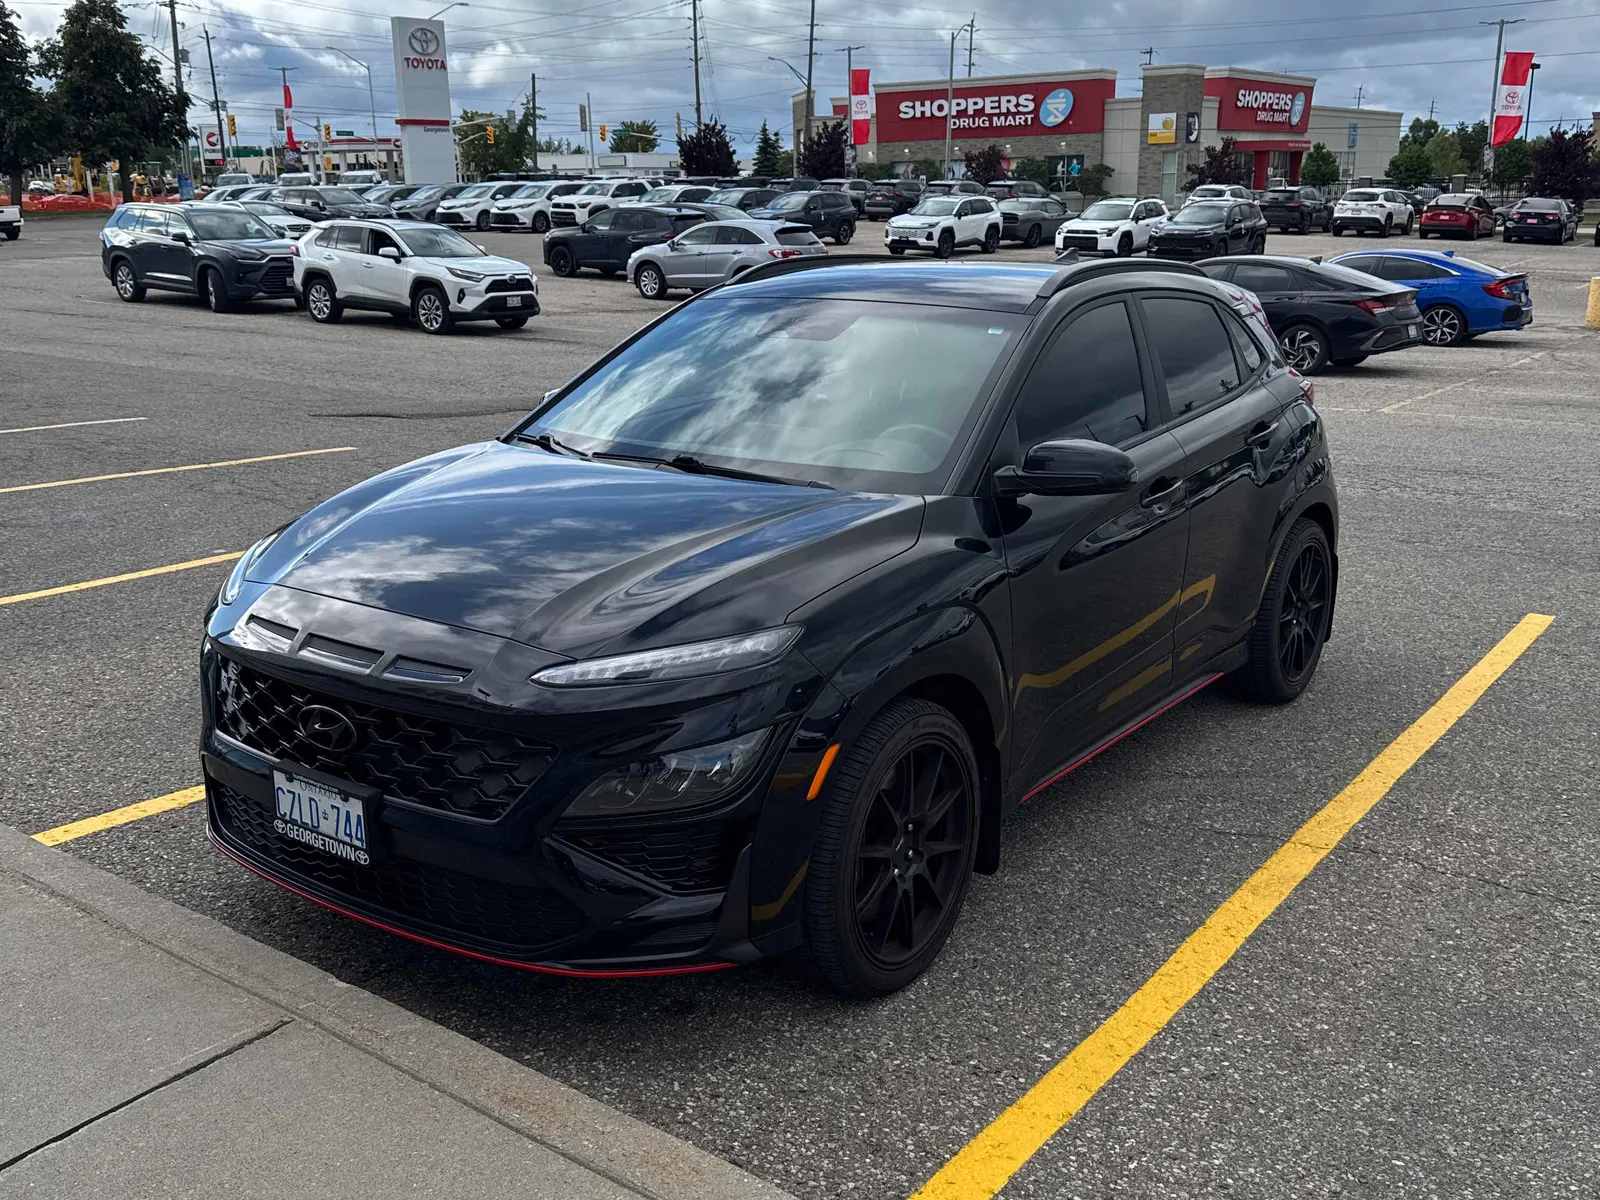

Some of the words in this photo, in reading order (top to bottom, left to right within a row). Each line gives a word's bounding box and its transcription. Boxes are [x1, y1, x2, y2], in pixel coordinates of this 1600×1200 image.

[404, 58, 446, 70] TOYOTA
[898, 94, 1035, 119] SHOPPERS
[1237, 89, 1292, 110] SHOPPERS
[950, 117, 990, 129] DRUG
[993, 114, 1035, 127] MART
[1256, 111, 1274, 121] DRUG
[1273, 112, 1290, 122] MART
[300, 781, 337, 800] ONTARIO
[276, 787, 320, 830] CZLD
[331, 804, 364, 847] 744
[287, 823, 355, 861] GEORGETOWN
